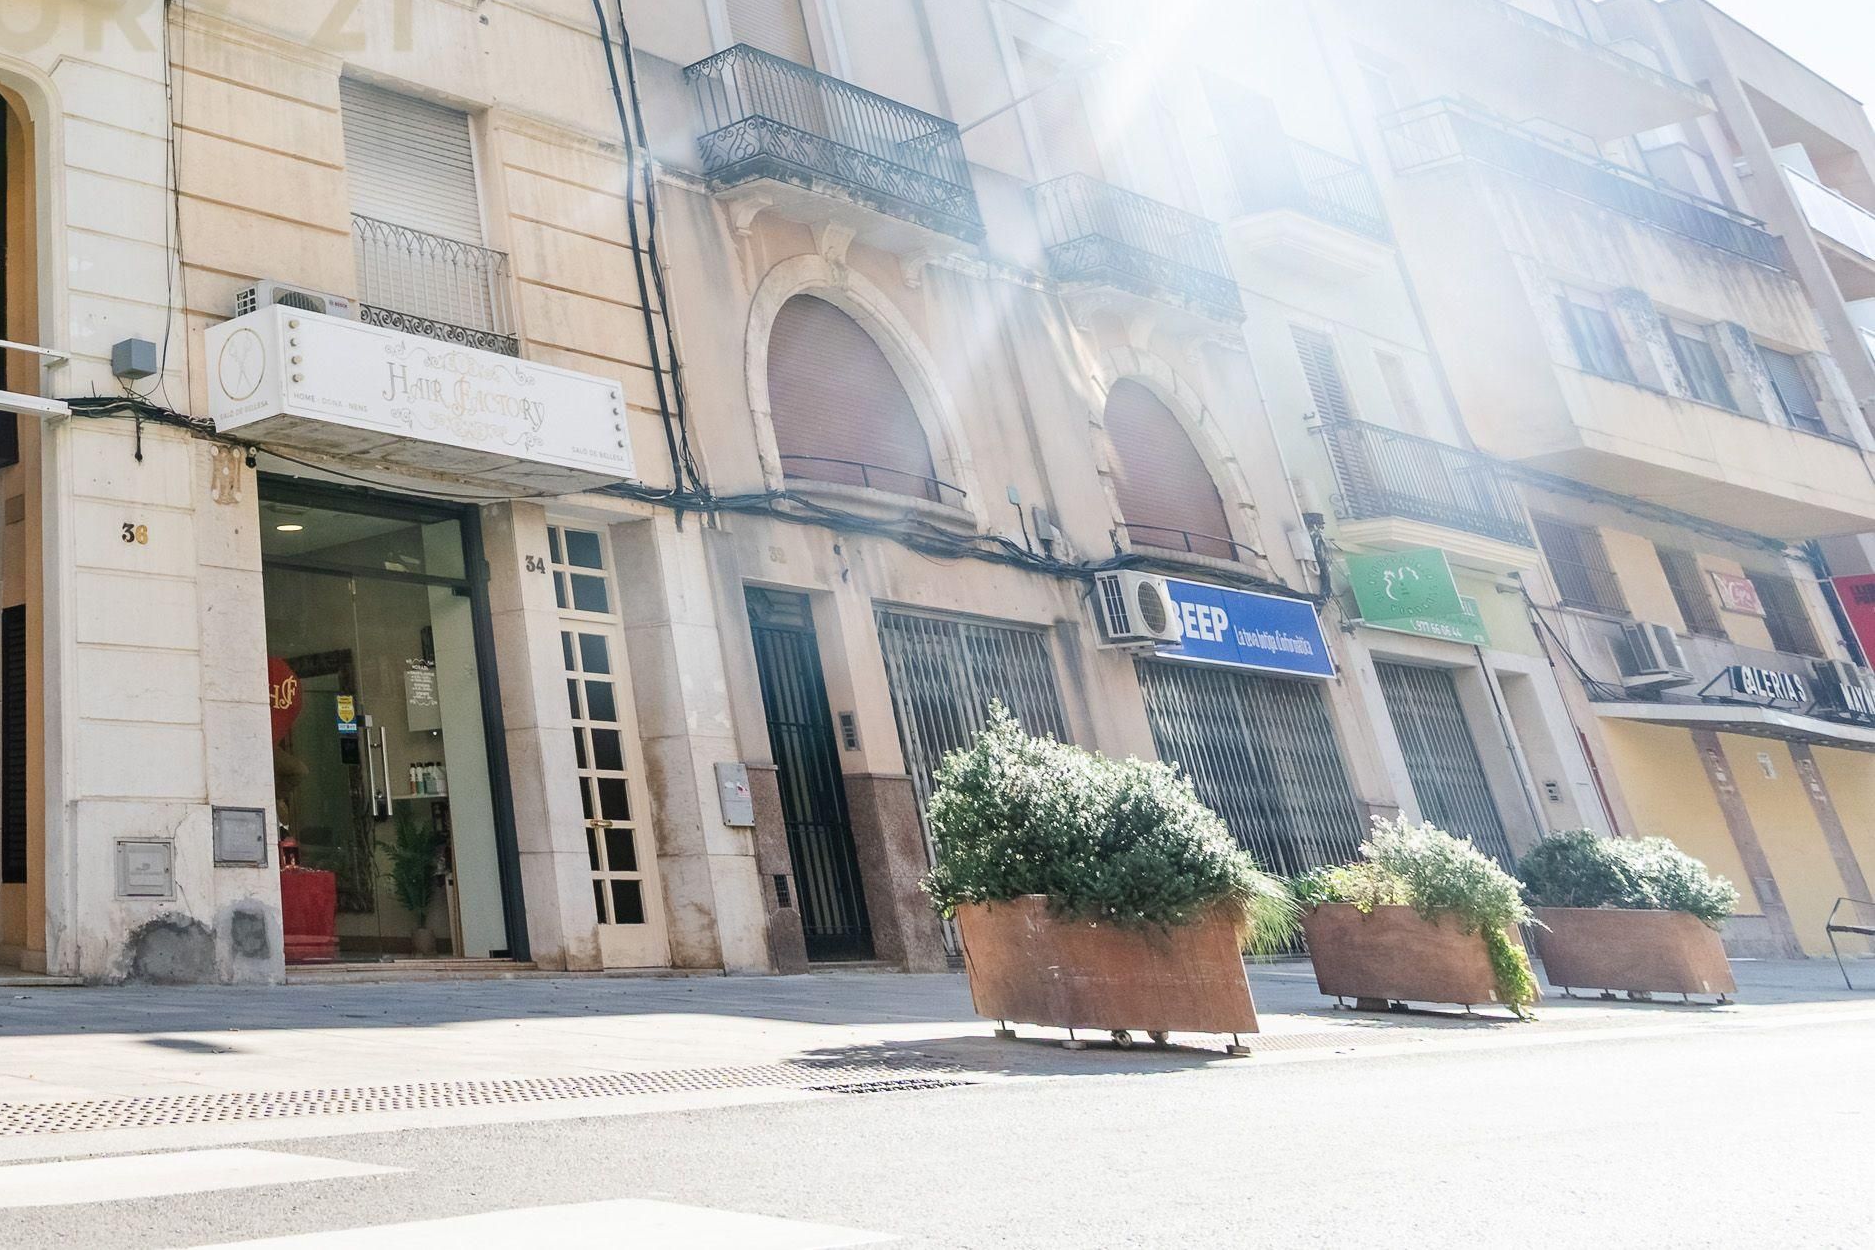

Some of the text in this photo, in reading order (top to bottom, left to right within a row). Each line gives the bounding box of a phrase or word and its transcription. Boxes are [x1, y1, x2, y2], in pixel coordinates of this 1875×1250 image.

[382, 362, 545, 432] HAIR FACTORY
[121, 522, 149, 545] 36
[525, 554, 546, 575] 34
[1741, 665, 1807, 703] GALERIAS
